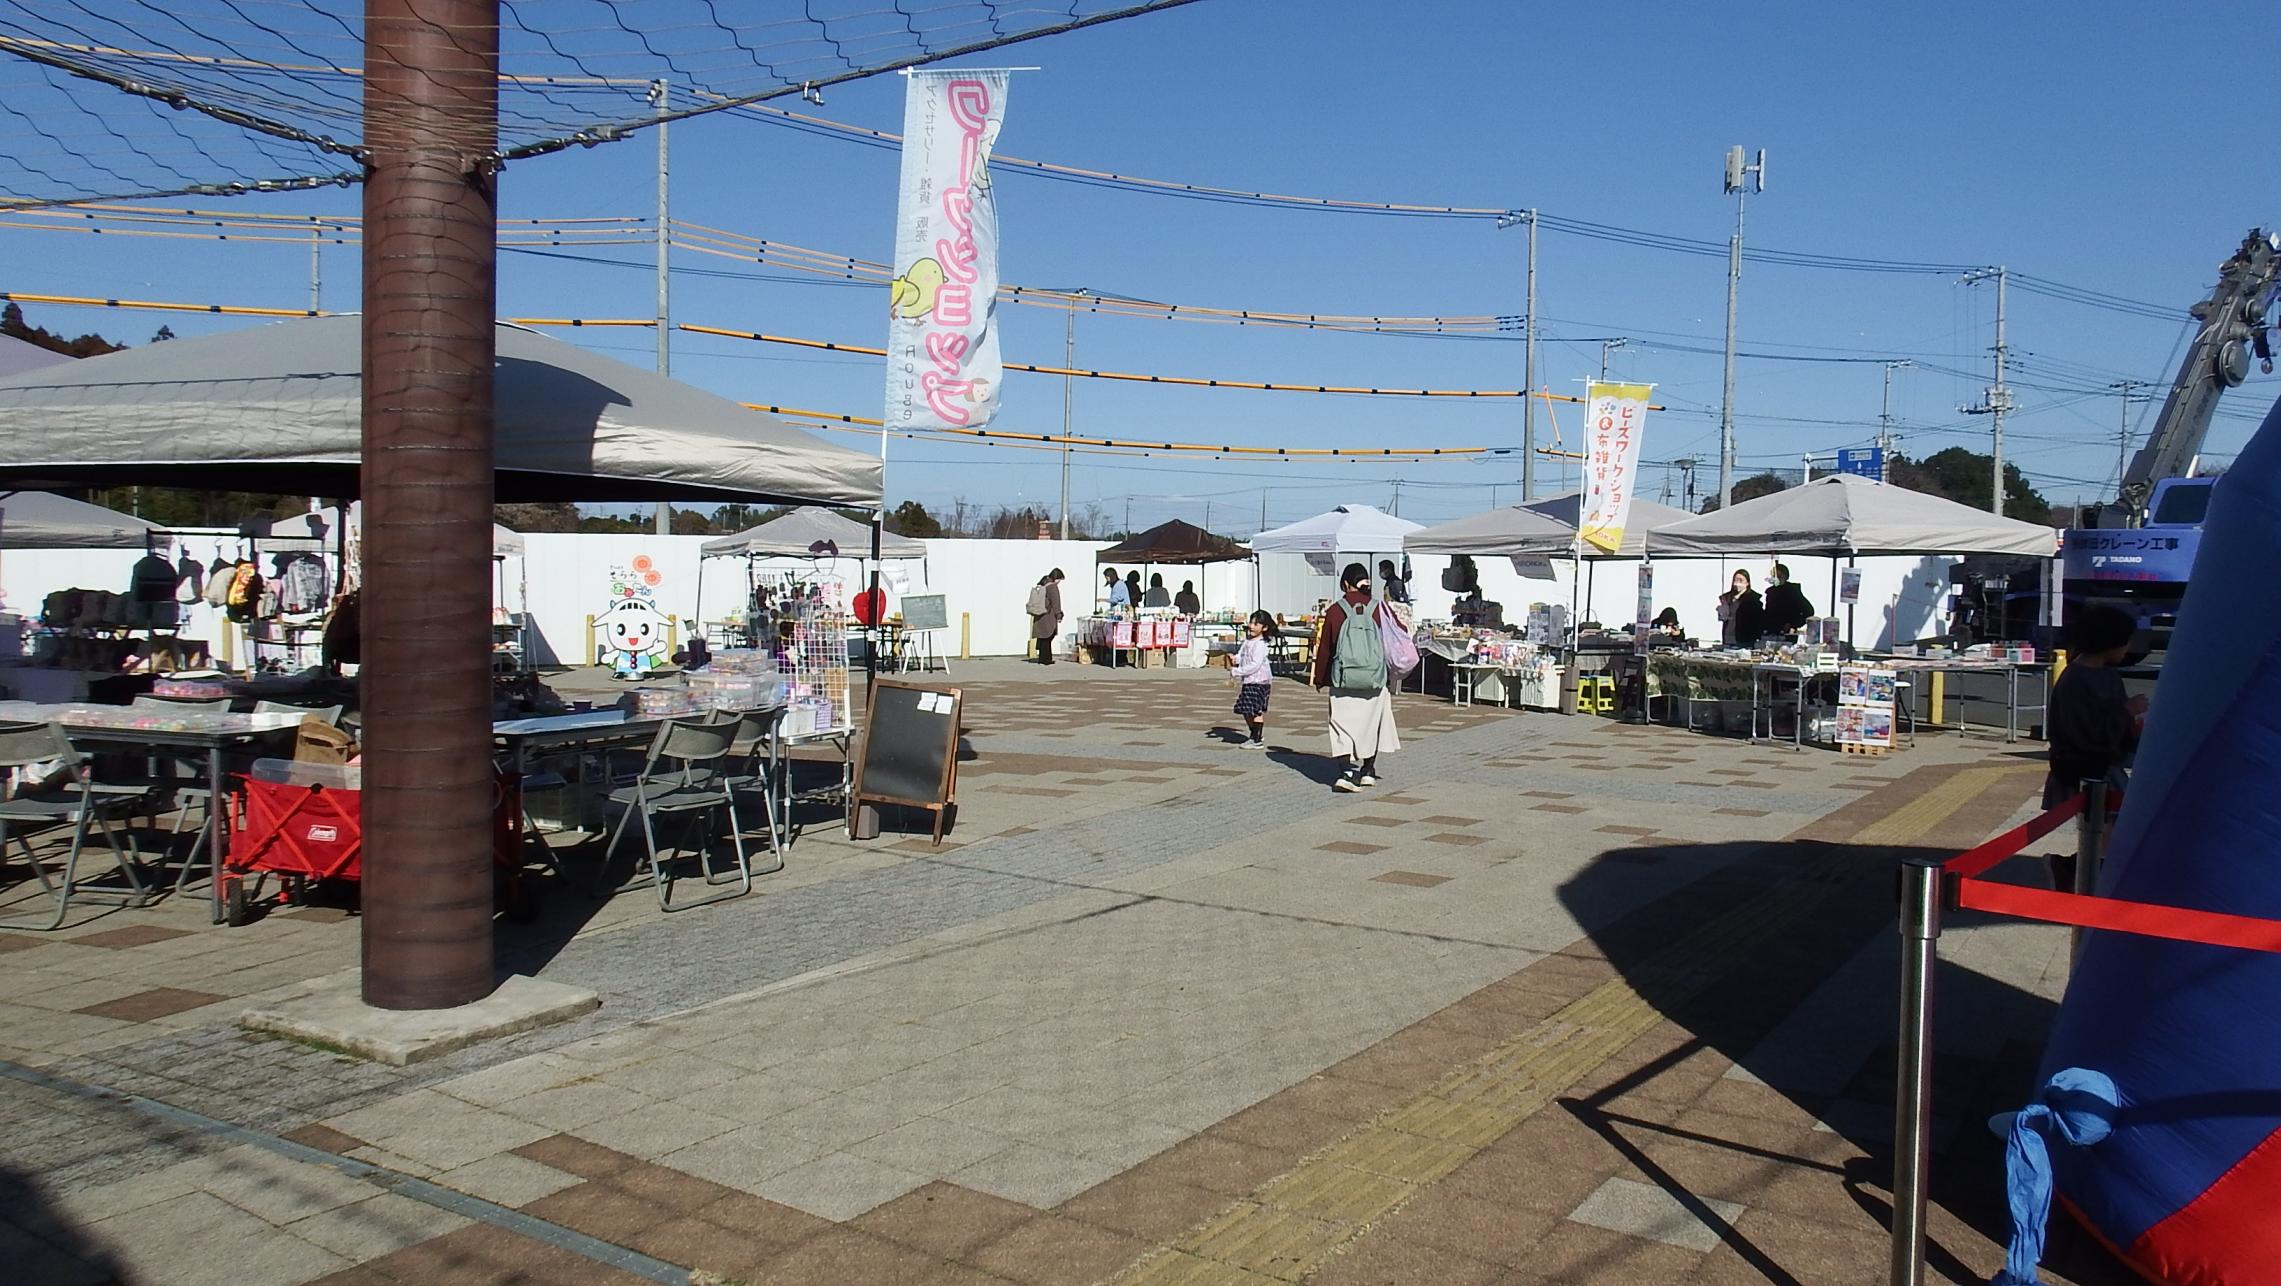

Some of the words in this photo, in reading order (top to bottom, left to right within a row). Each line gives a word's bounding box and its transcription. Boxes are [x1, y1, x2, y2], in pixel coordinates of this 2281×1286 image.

[1607, 406, 1637, 522] ビーズワークショップ
